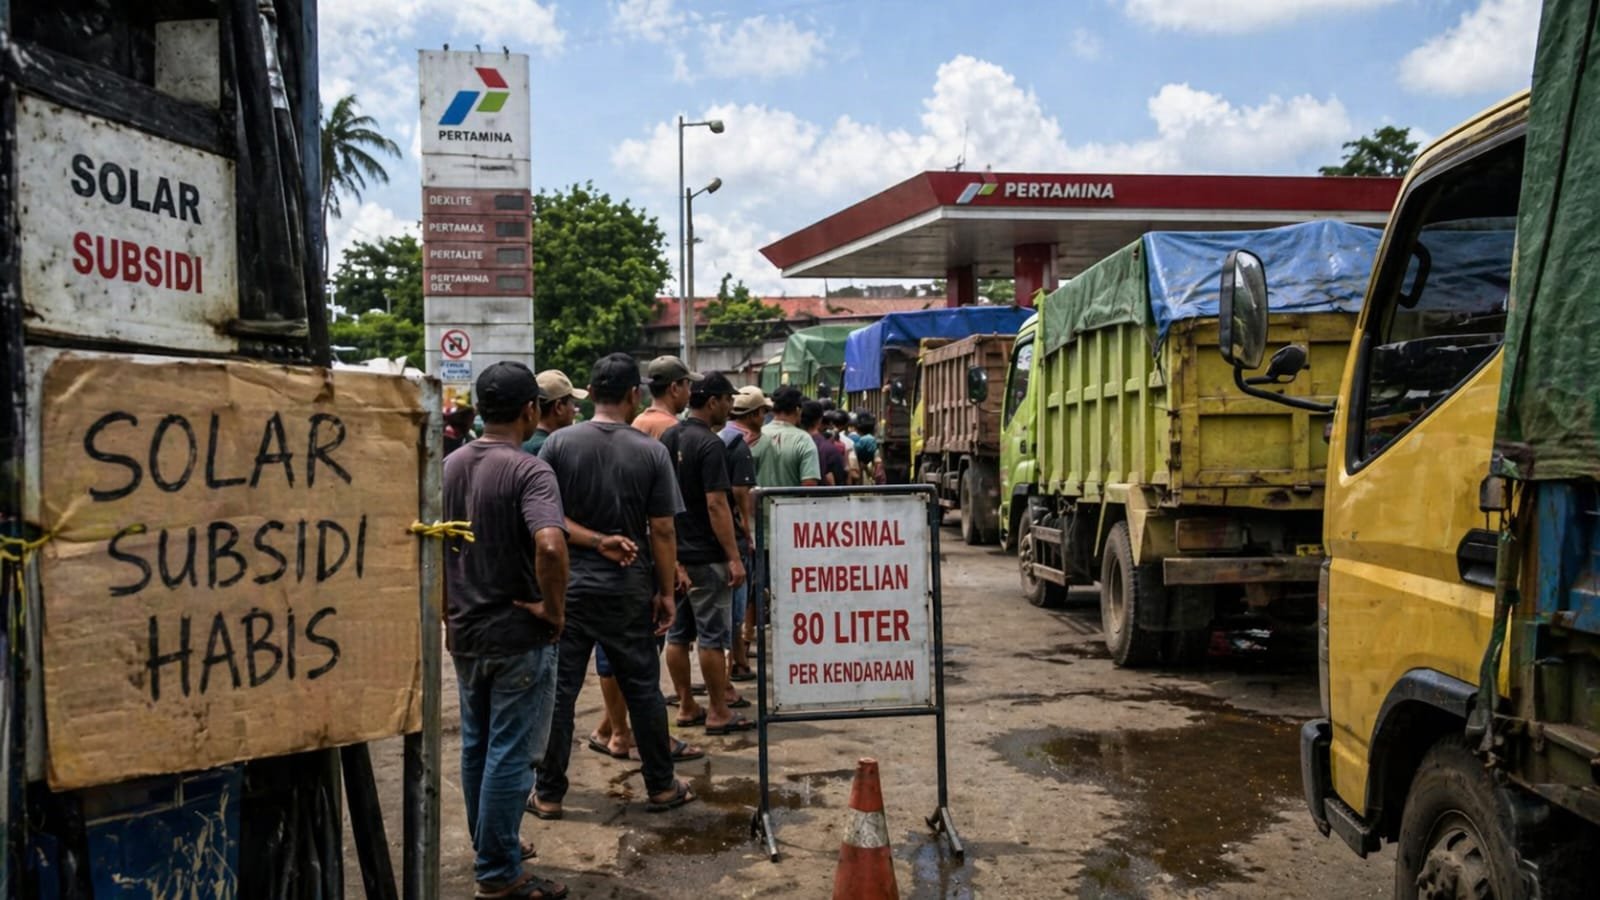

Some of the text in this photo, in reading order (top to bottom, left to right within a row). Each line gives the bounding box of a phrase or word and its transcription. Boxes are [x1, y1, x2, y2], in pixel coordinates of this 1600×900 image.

[438, 130, 513, 143] PERTAMINA
[71, 153, 202, 225] SOLAR
[429, 195, 473, 206] DEXLITE
[1004, 182, 1115, 198] PERTAMINA
[429, 222, 486, 233] PERTAMAX
[72, 231, 203, 294] SUBSIDI
[430, 250, 484, 260] PERTALITE
[430, 273, 490, 283] PERTAMINA
[83, 410, 353, 502] SOLAR
[793, 520, 905, 549] MAKSIMAL
[107, 514, 368, 597] SUBSIDI
[791, 564, 909, 594] PEMBELIAN
[792, 609, 911, 646] 80 LITER
[146, 606, 342, 701] HABIS
[789, 660, 915, 685] PER KENDARAAN
